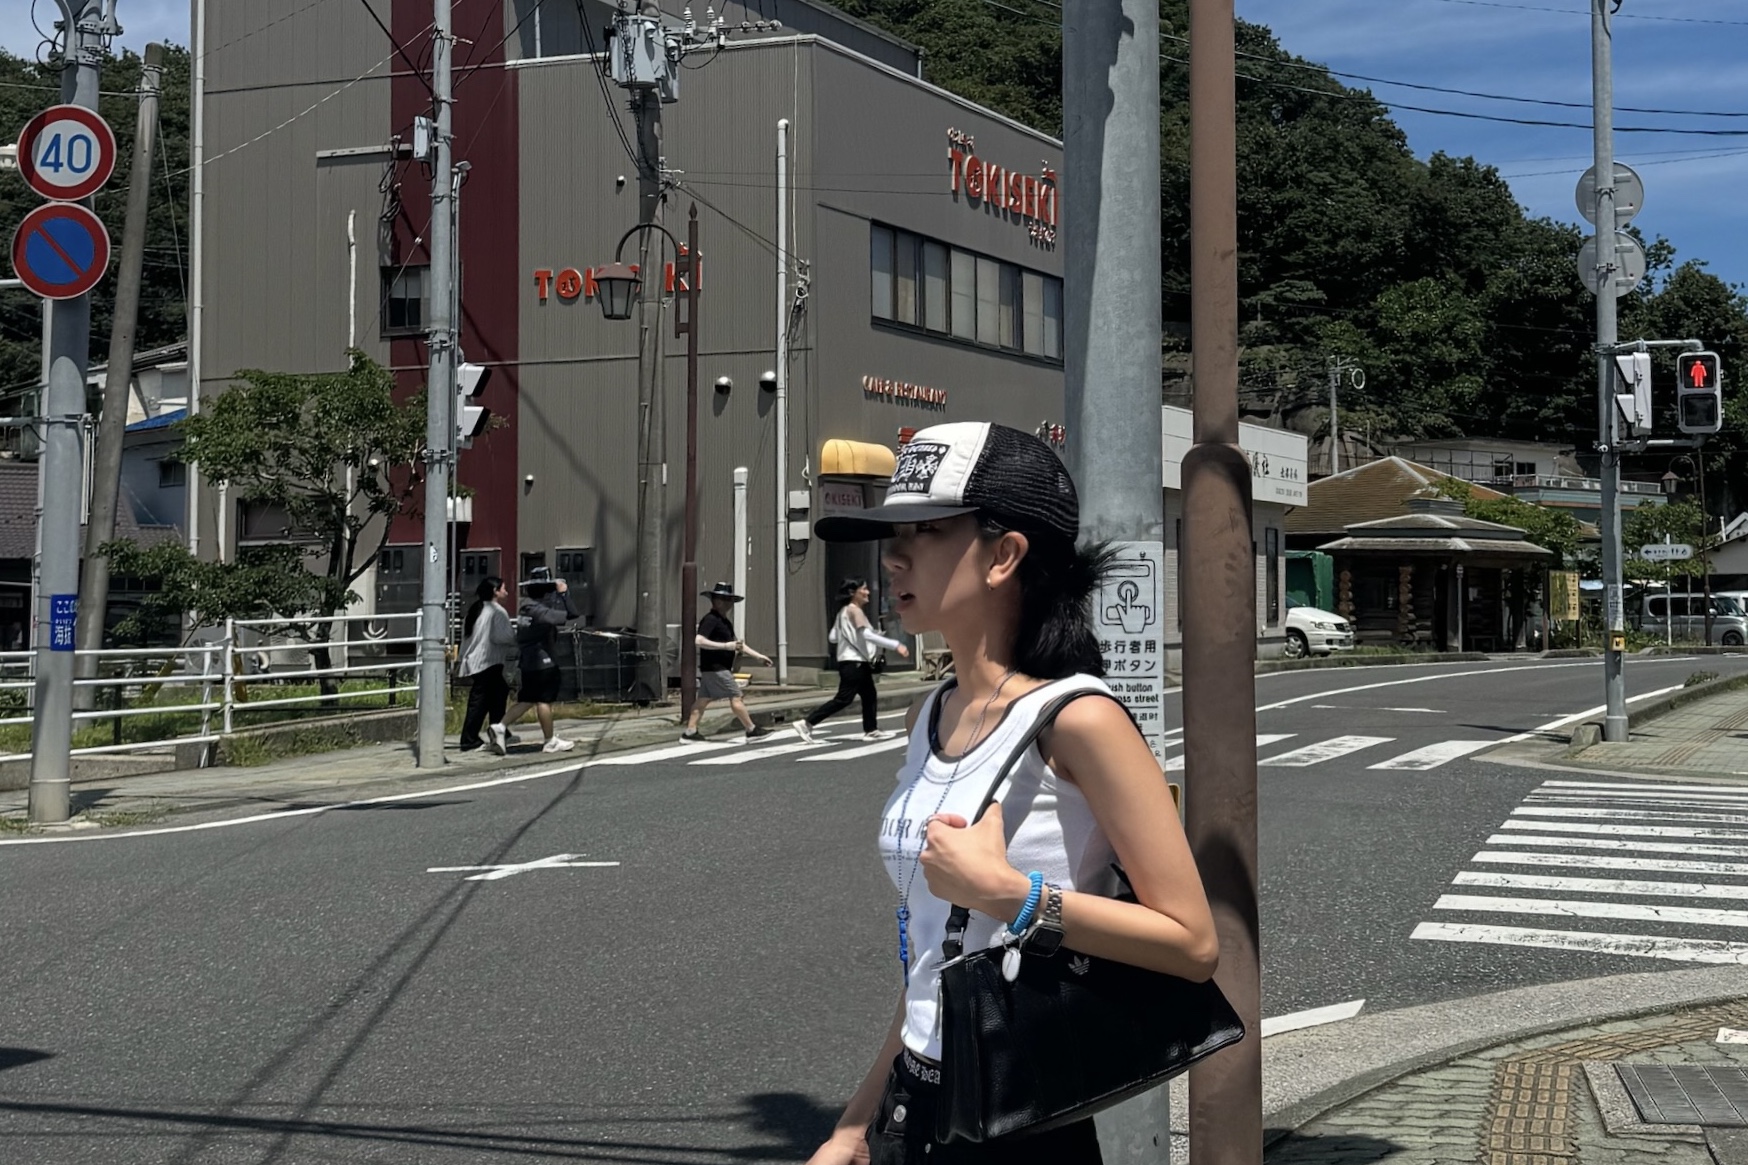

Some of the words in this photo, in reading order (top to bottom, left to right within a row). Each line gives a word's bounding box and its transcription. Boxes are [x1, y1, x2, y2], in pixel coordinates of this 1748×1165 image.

[40, 133, 91, 173] 40
[947, 147, 1058, 227] TOKISEKI
[1100, 640, 1156, 654] 歩行者用
[1126, 683, 1153, 693] button
[1134, 693, 1159, 703] street
